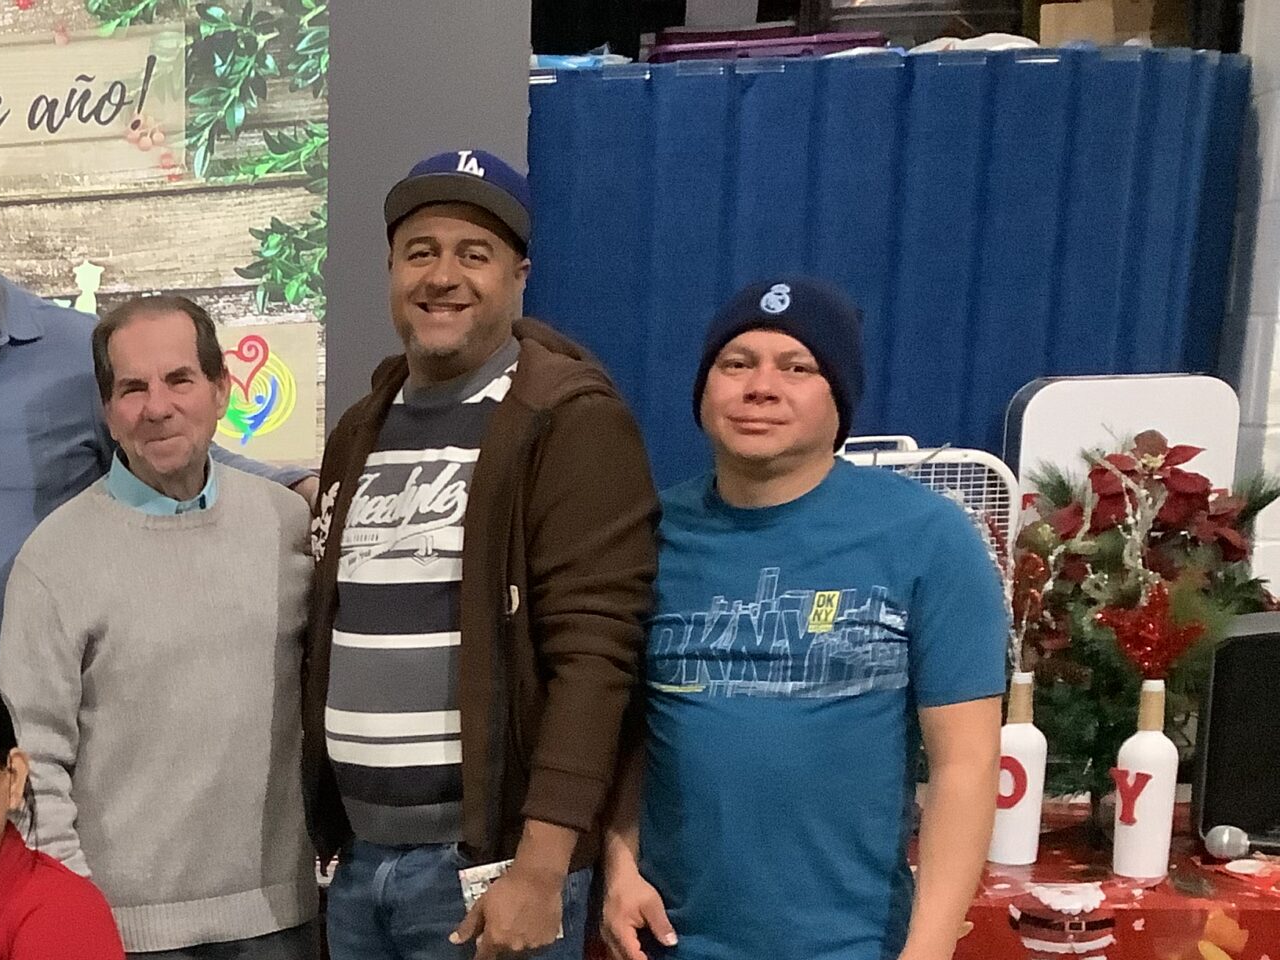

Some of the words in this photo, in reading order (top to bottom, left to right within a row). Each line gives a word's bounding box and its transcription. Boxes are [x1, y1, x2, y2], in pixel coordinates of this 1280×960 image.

[27, 54, 157, 134] año!
[456, 150, 485, 177] LA
[1111, 768, 1152, 824] Y
